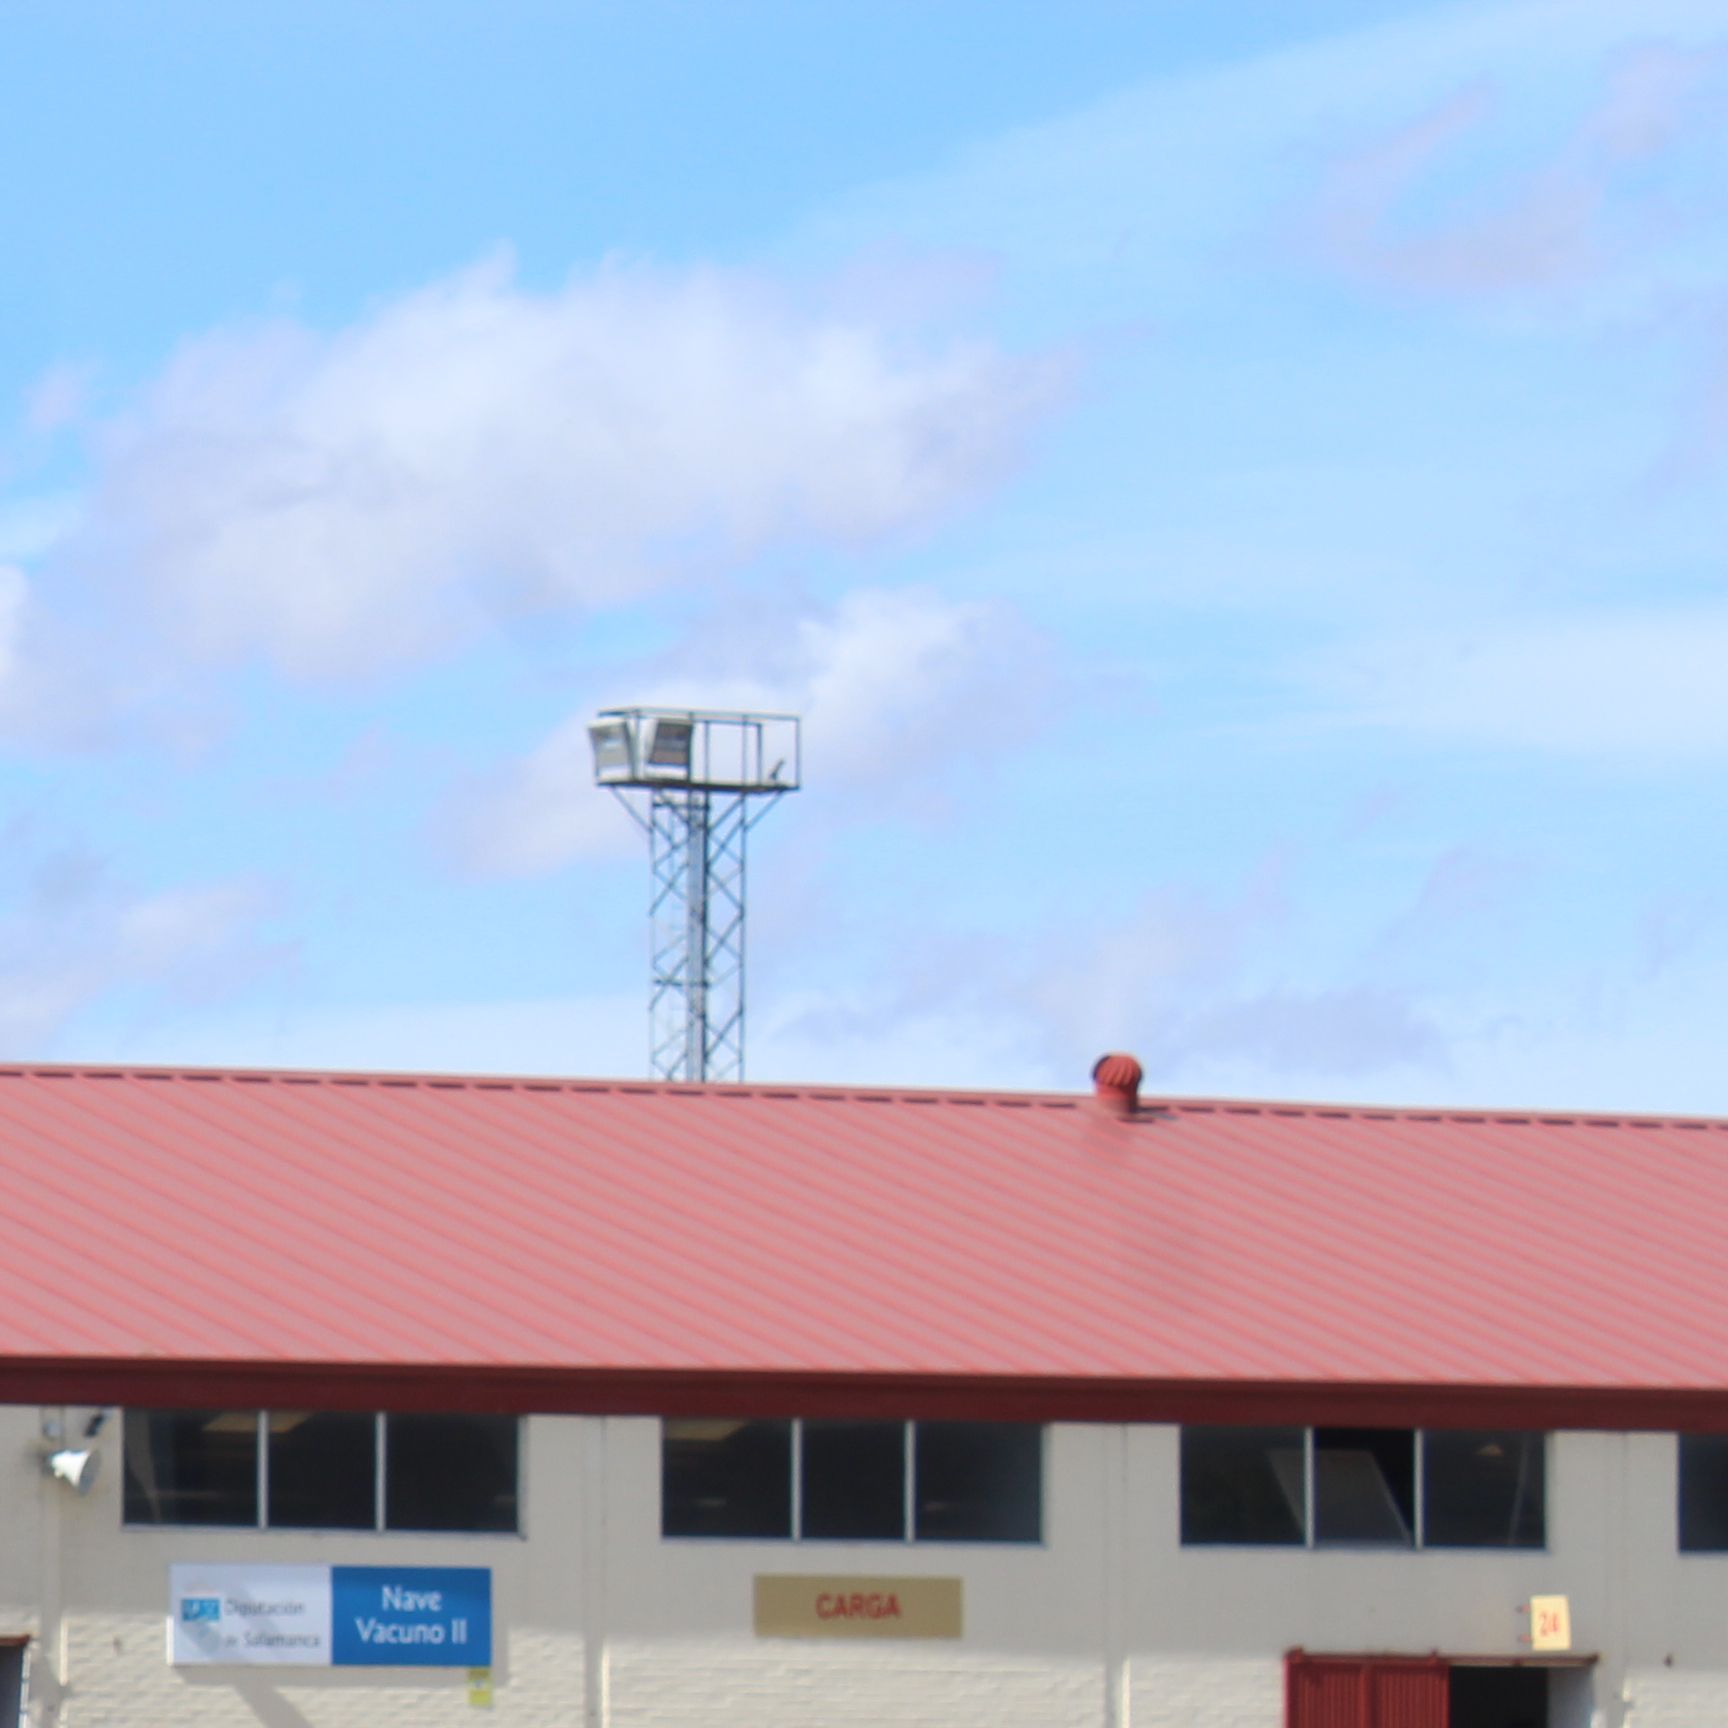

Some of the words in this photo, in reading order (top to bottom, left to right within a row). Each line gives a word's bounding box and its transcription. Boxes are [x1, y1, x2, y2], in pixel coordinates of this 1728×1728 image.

[382, 1584, 442, 1612] Nave
[815, 1593, 901, 1620] CARGA
[354, 1616, 445, 1644] Vacuno
[451, 1617, 467, 1644] II
